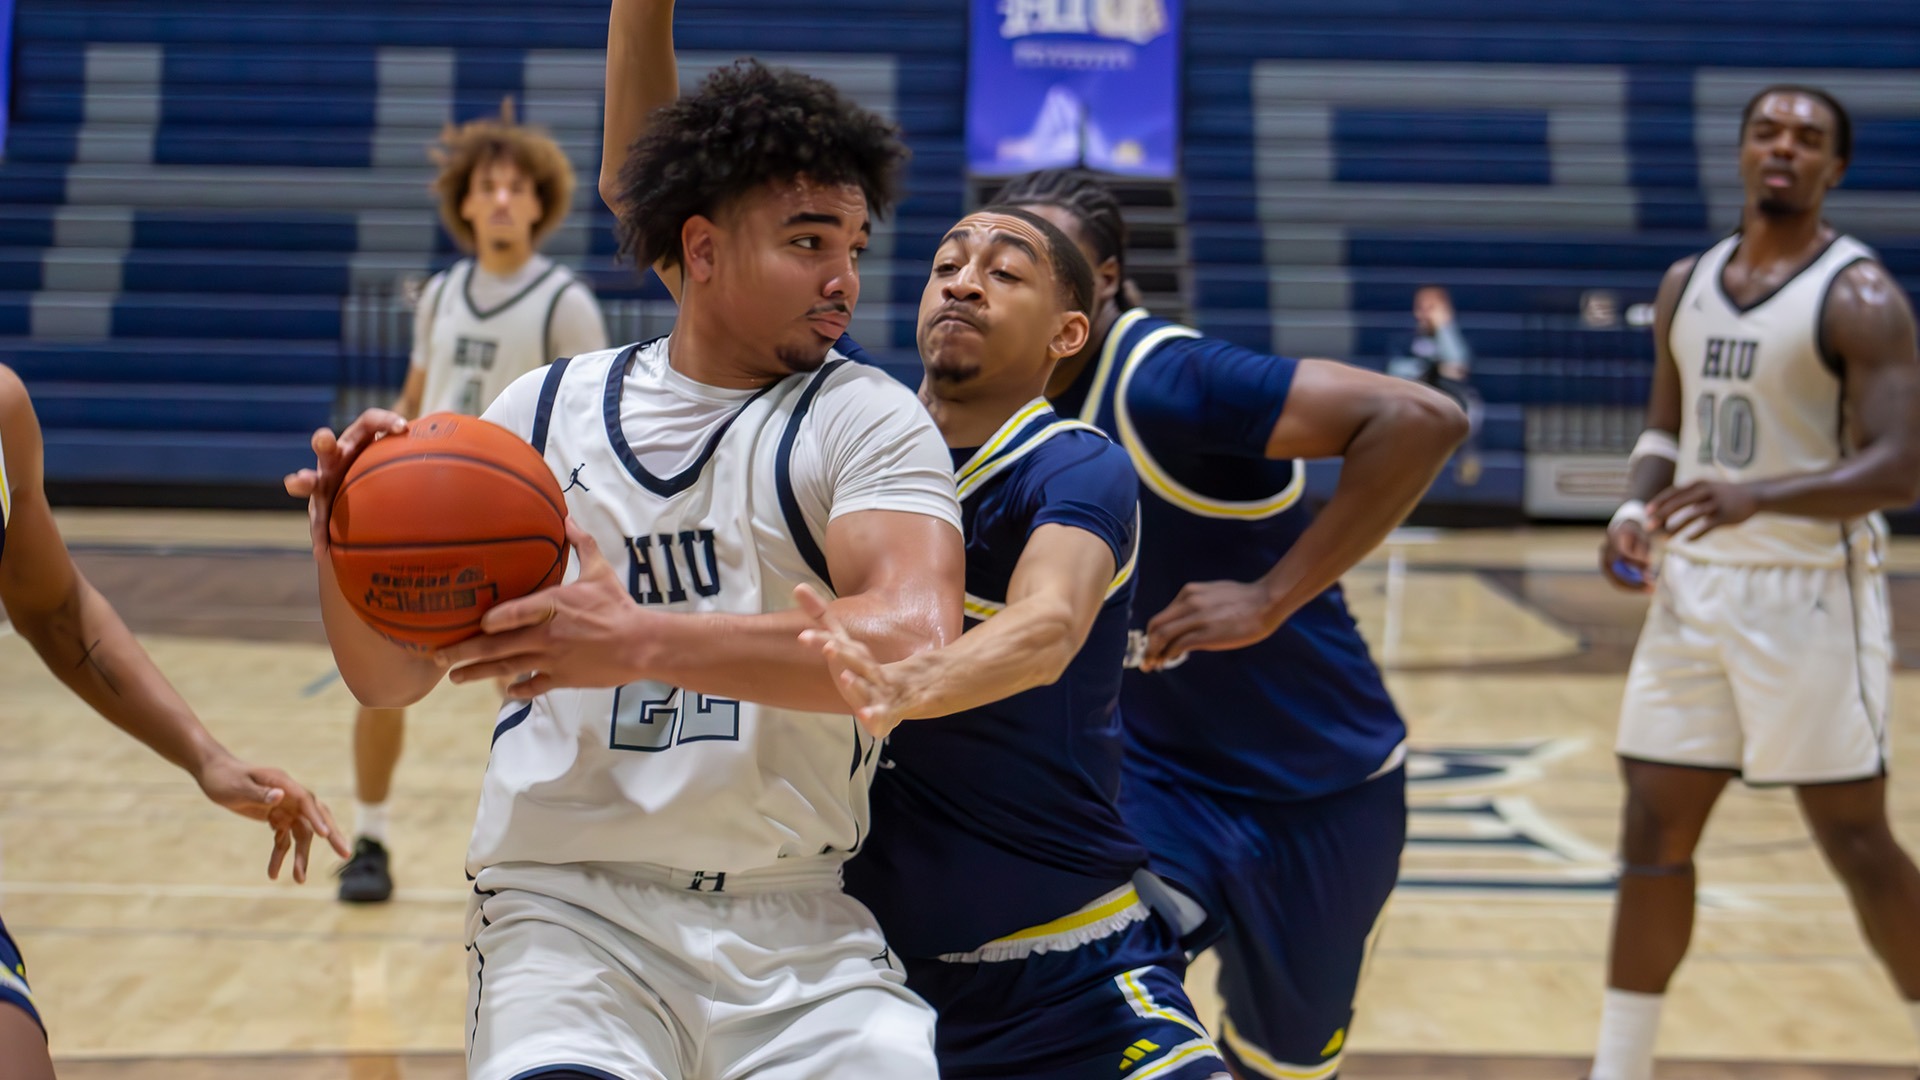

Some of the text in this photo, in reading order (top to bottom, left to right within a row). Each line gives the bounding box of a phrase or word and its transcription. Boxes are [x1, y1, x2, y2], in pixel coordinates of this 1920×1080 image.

[1702, 337, 1759, 381] HIU
[1696, 392, 1756, 470] 10
[624, 528, 723, 605] HIU
